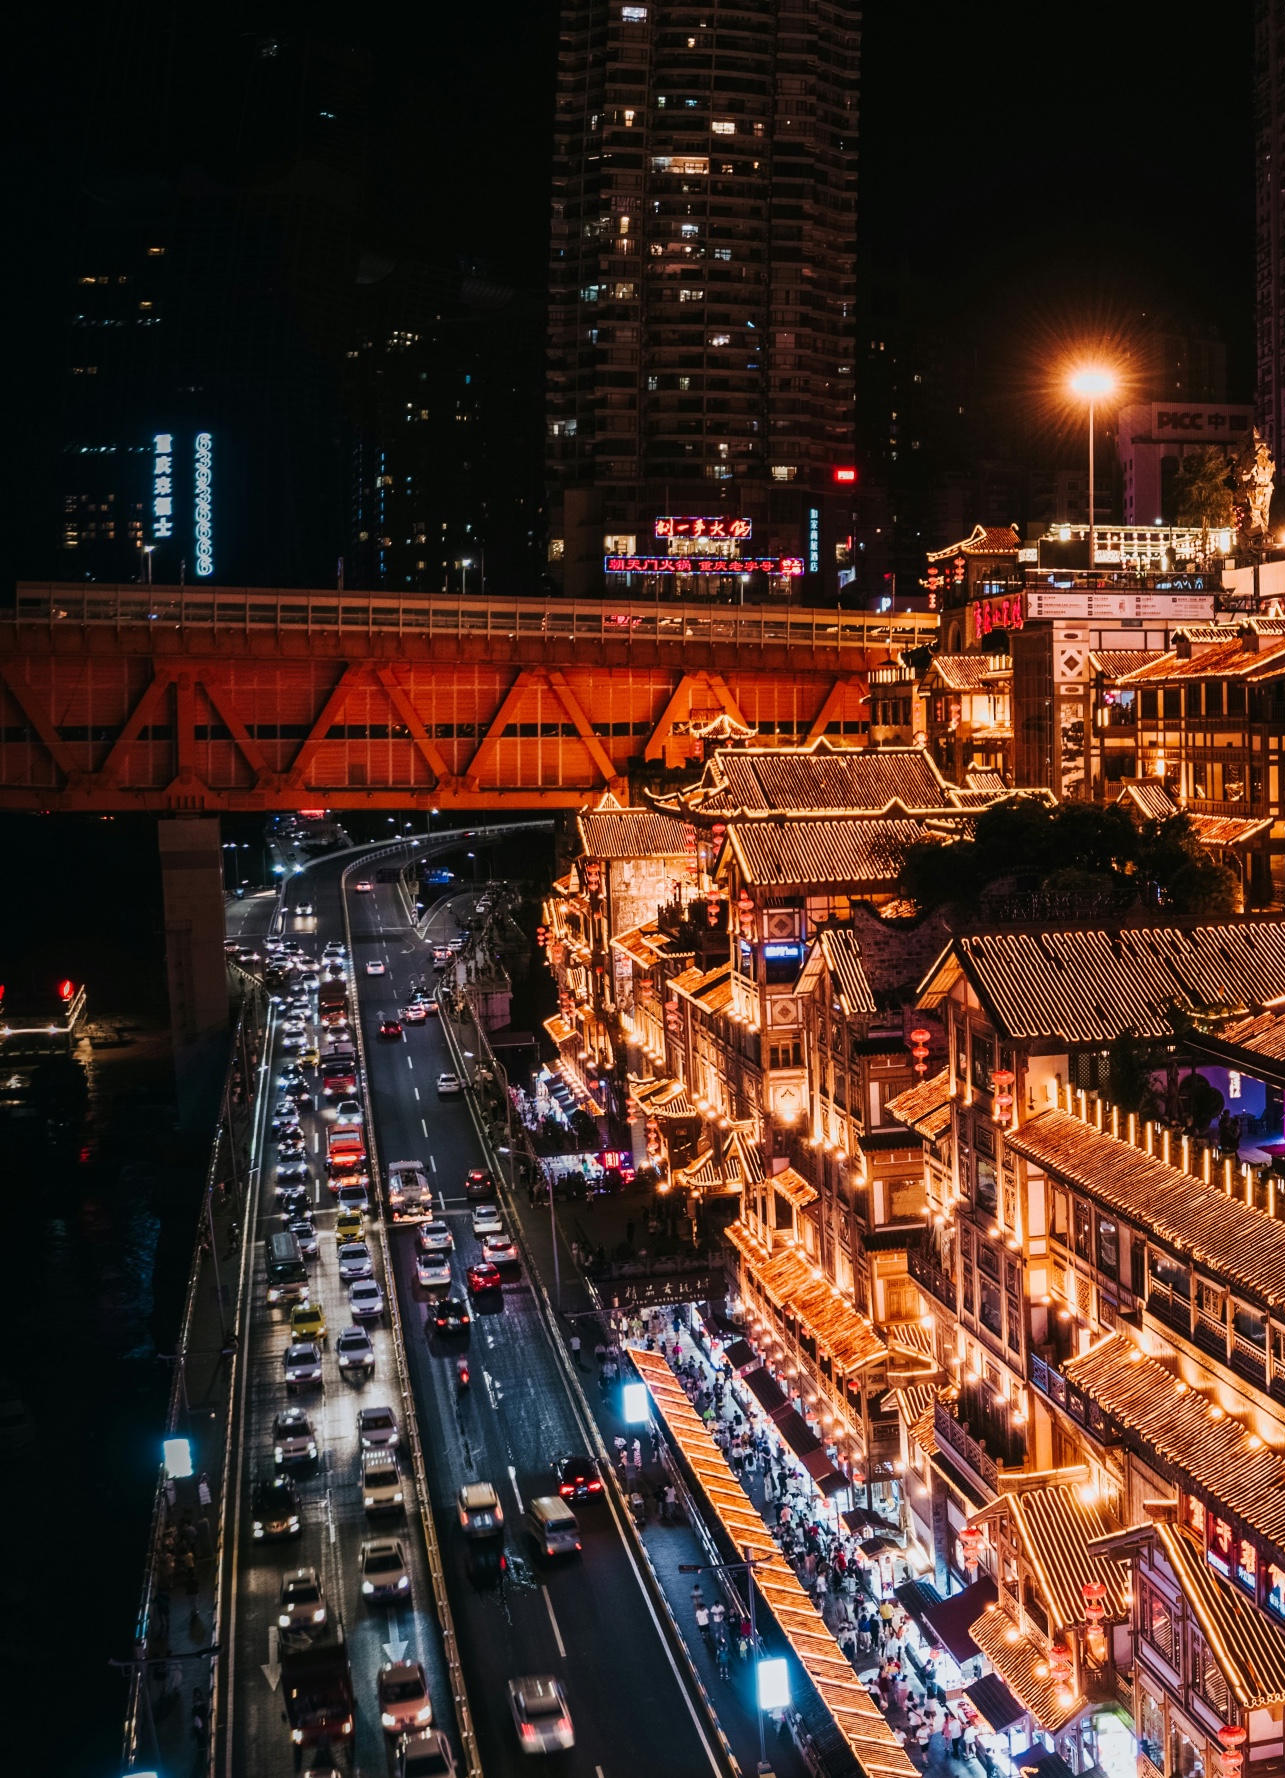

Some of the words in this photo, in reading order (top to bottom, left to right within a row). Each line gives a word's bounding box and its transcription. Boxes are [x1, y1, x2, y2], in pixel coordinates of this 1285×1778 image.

[1157, 411, 1203, 430] PICC
[608, 559, 691, 571] 朝天门火锅
[698, 560, 774, 572] 重庆老字号
